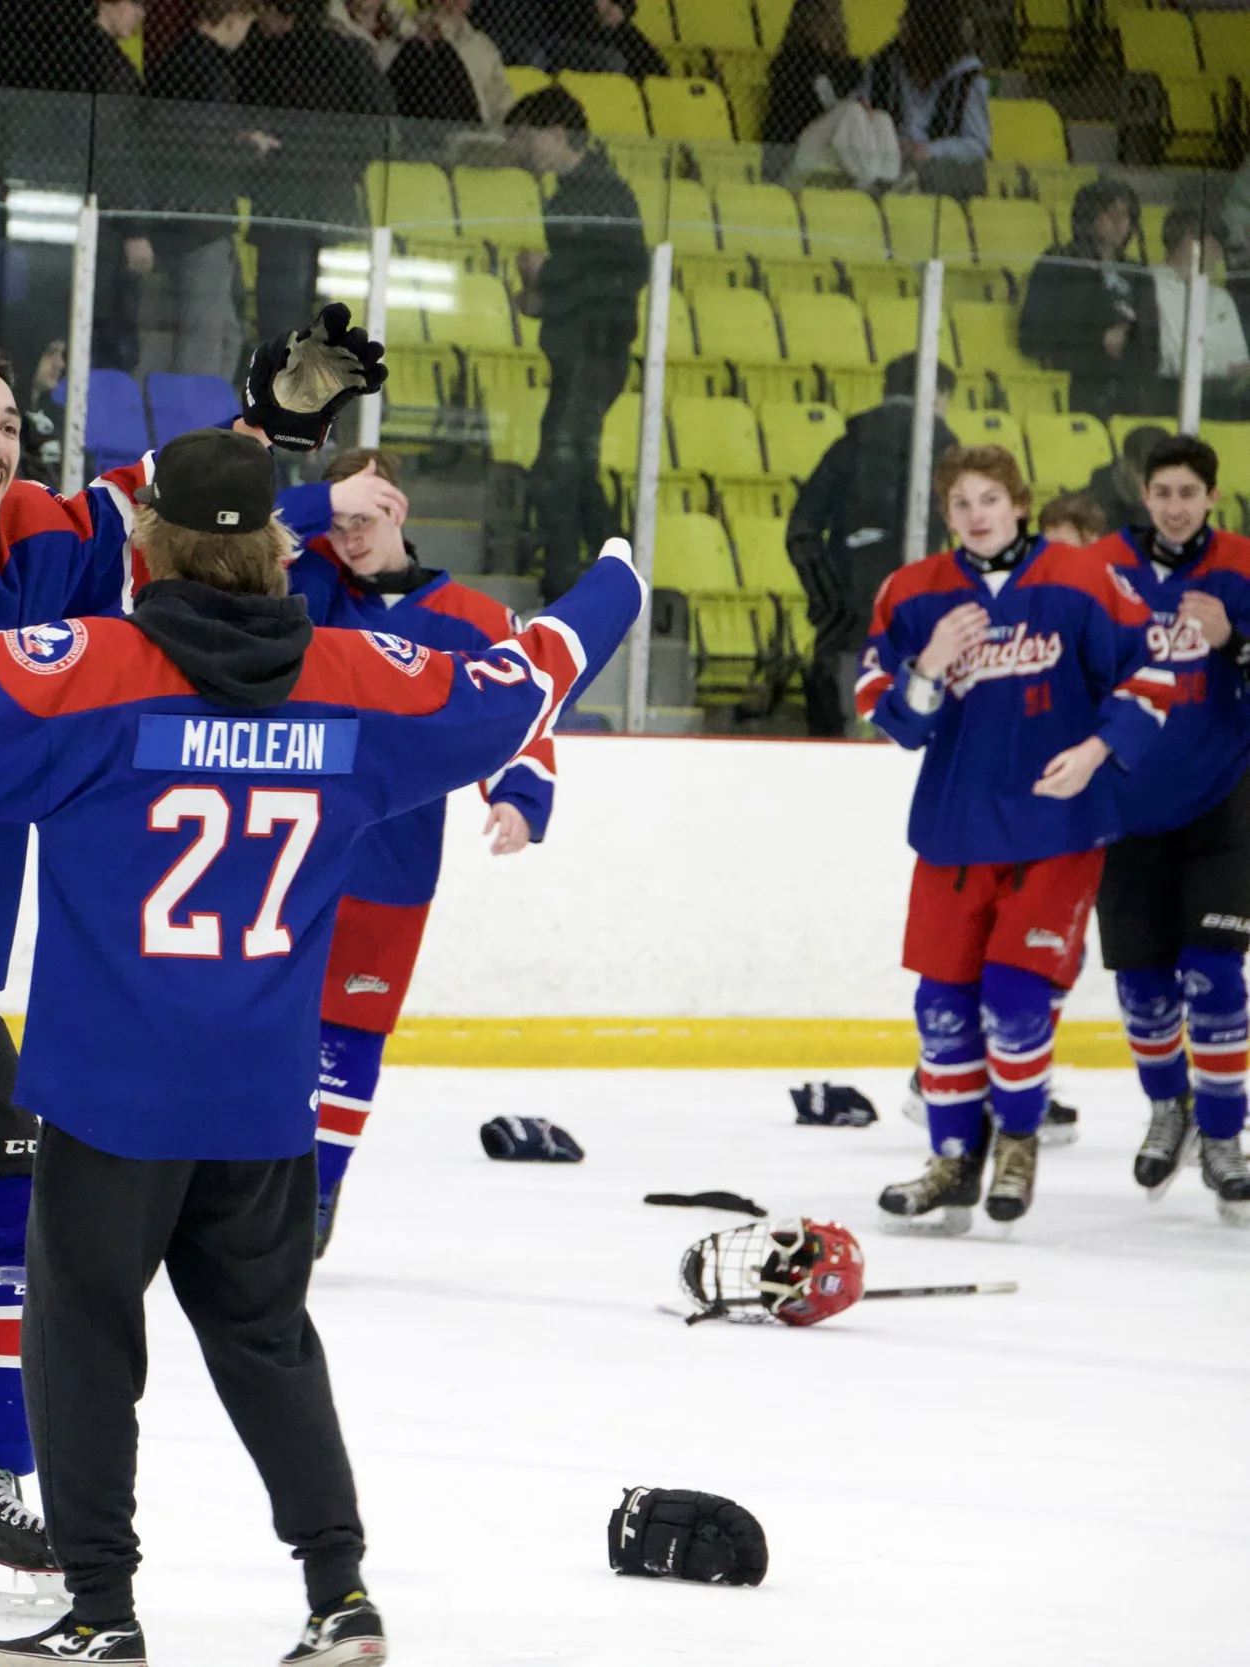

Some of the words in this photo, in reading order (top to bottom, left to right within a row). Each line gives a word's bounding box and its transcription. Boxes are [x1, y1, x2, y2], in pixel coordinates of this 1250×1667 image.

[181, 719, 325, 770] MACLEAN
[140, 784, 322, 960] 27
[1201, 912, 1250, 933] BAU
